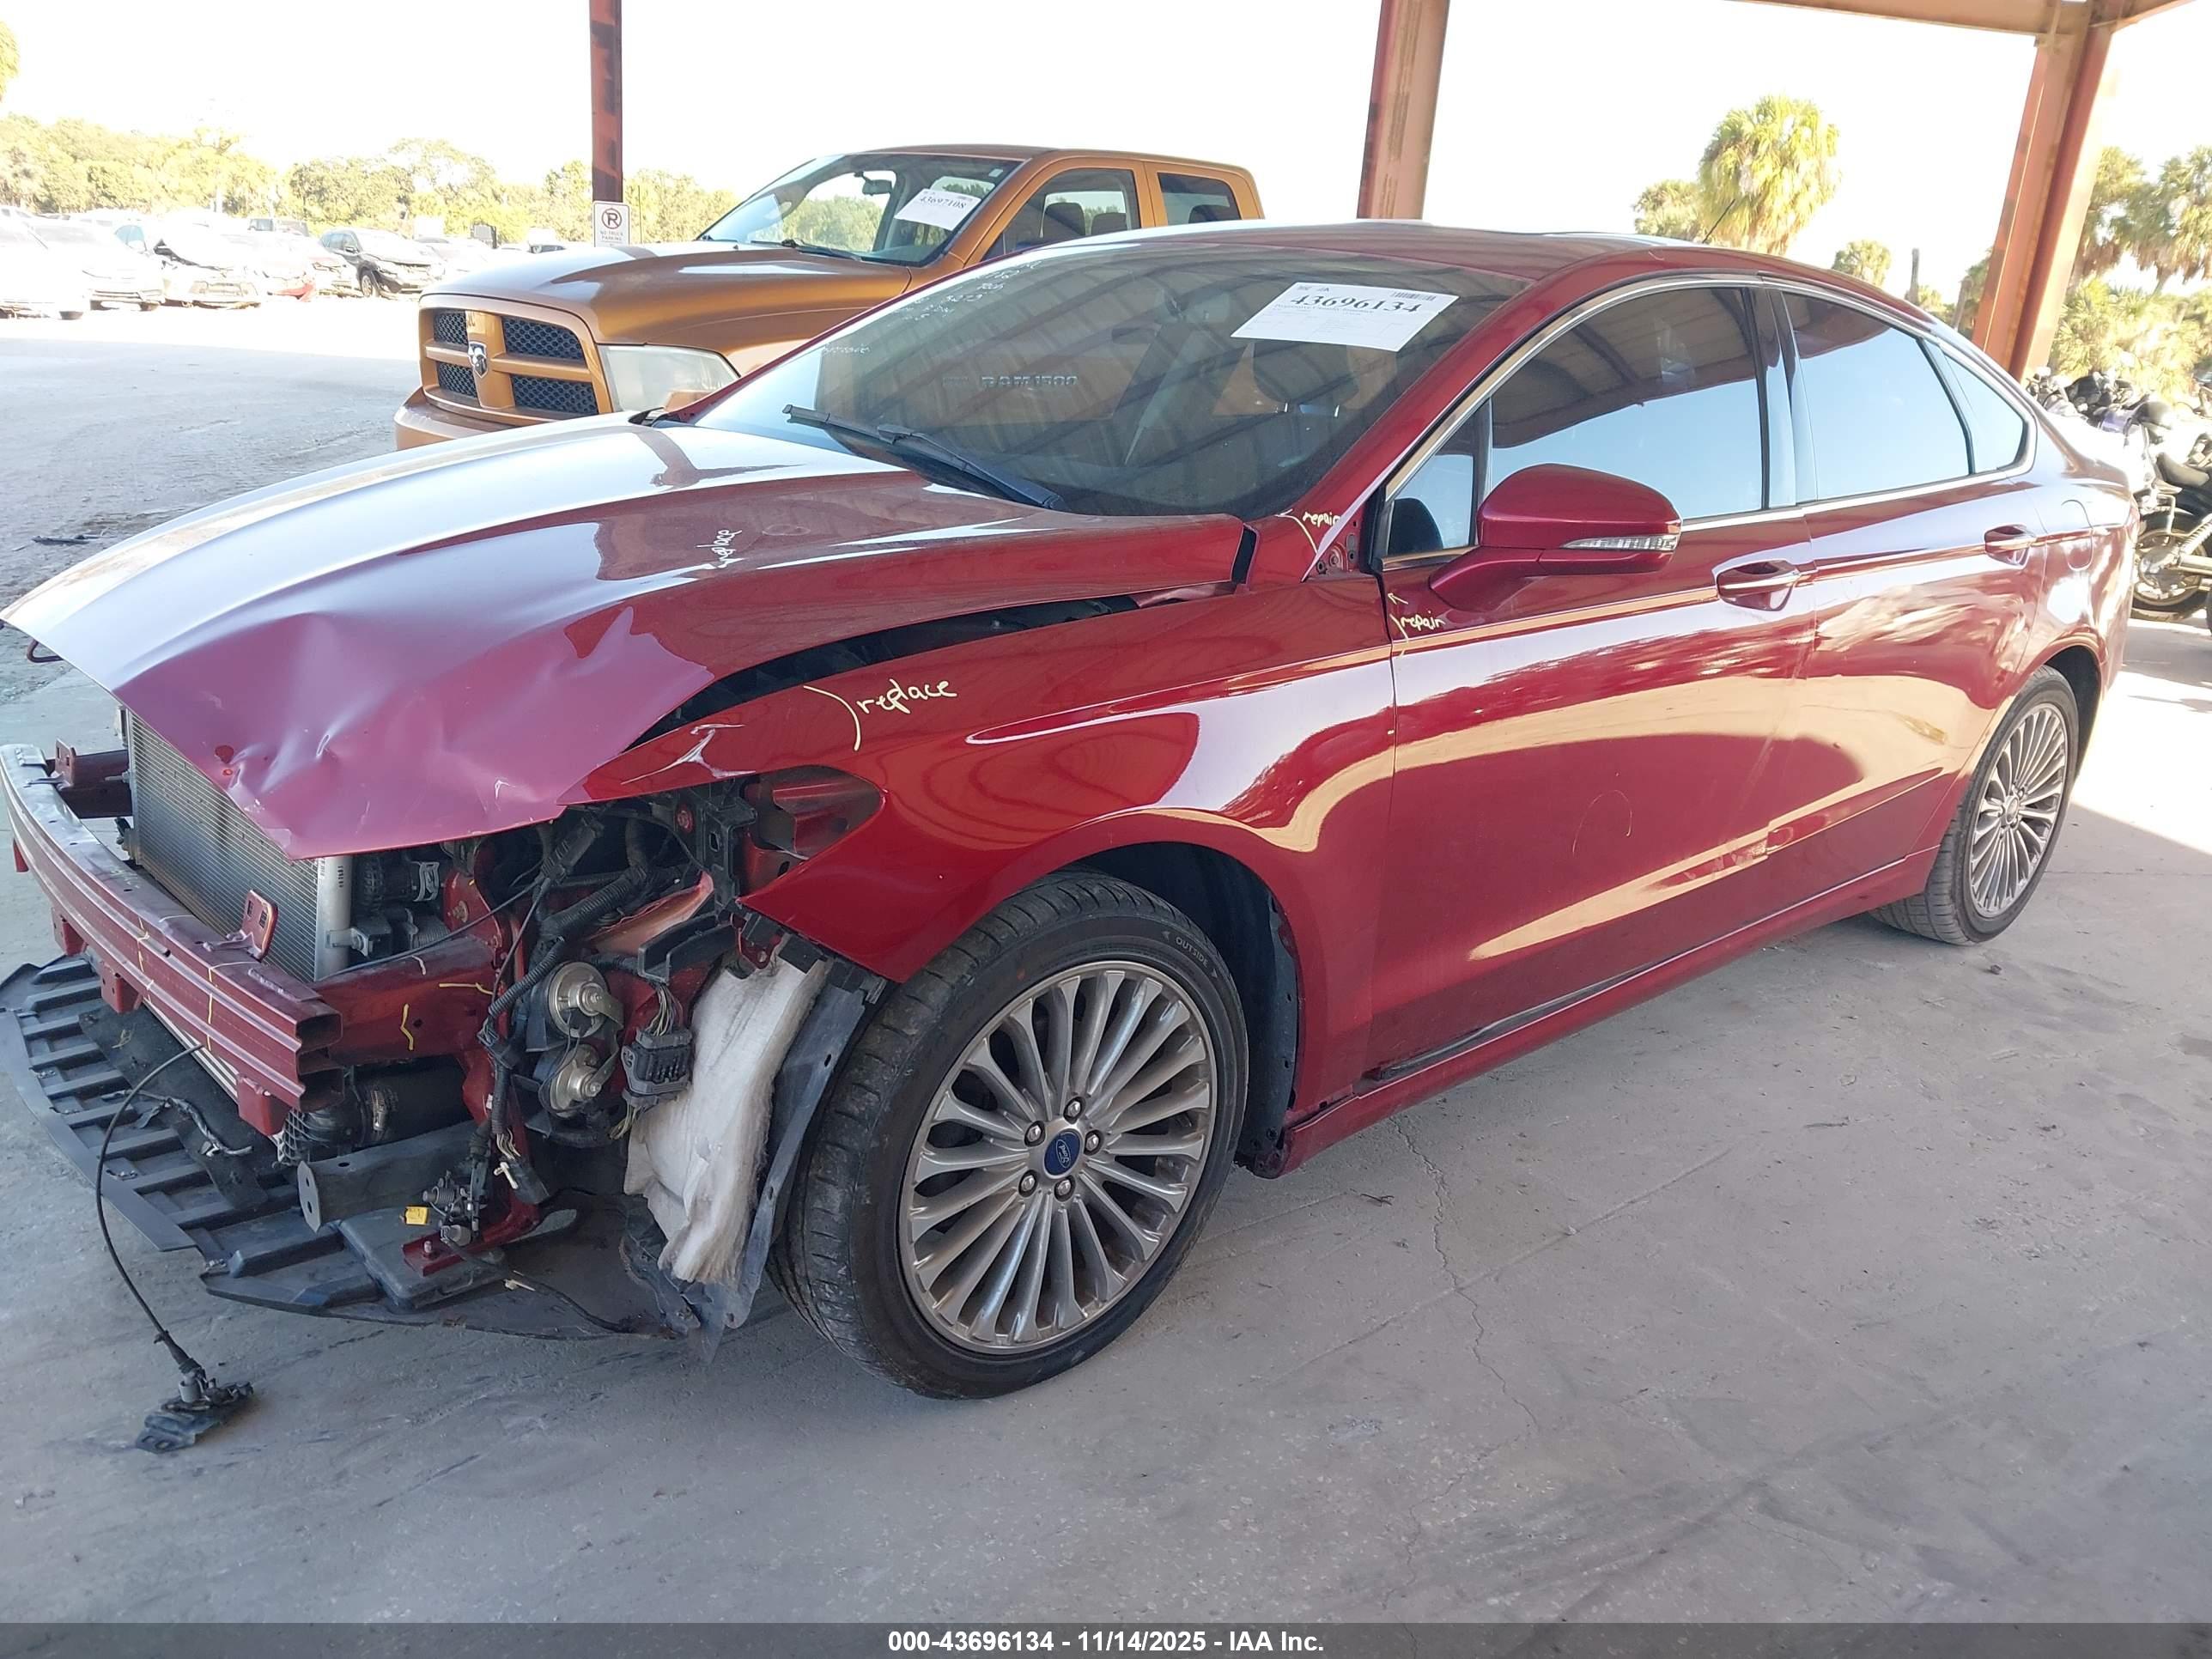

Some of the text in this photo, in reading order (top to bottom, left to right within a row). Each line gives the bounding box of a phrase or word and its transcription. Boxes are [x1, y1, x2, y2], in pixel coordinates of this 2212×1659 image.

[1291, 295, 1422, 313] 43696134
[1302, 511, 1342, 527] repair
[1400, 610, 1446, 631] repair
[856, 678, 957, 714] replace
[1176, 936, 1209, 968] OUTSIDE
